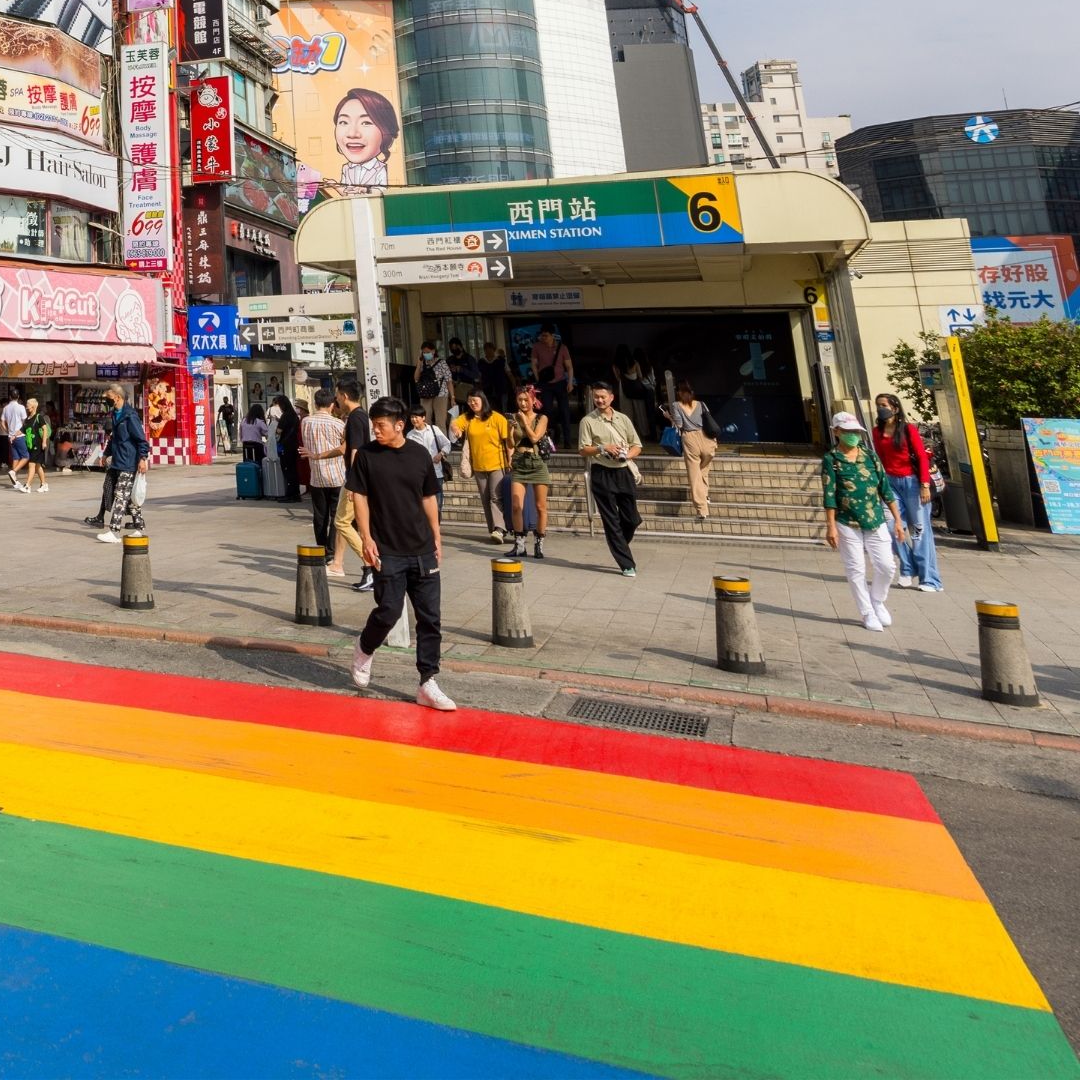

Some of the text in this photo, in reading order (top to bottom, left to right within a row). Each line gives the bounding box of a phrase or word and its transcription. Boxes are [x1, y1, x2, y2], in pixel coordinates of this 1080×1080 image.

[126, 48, 159, 63] 玉芙蓉
[212, 47, 221, 55] 4F
[10, 88, 24, 99] SPA
[27, 84, 57, 105] 按摩
[60, 92, 78, 112] 護膚
[129, 75, 157, 123] 按摩
[130, 130, 157, 138] Massage
[135, 125, 151, 134] Body
[202, 117, 220, 174] 小蒙牛
[27, 149, 71, 177] Hair
[73, 160, 107, 189] Salon
[131, 143, 157, 192] 護膚
[129, 200, 162, 208] Treatment
[507, 196, 597, 226] 西門站
[688, 192, 721, 232] 6
[427, 236, 461, 247] 西門紅樓
[508, 226, 602, 241] XIMEN STATION
[380, 243, 395, 251] 70m
[383, 270, 403, 279] 300m
[978, 262, 1049, 285] 存好股
[803, 285, 819, 305] 6
[983, 288, 1056, 311] 找元大
[370, 374, 378, 386] 6
